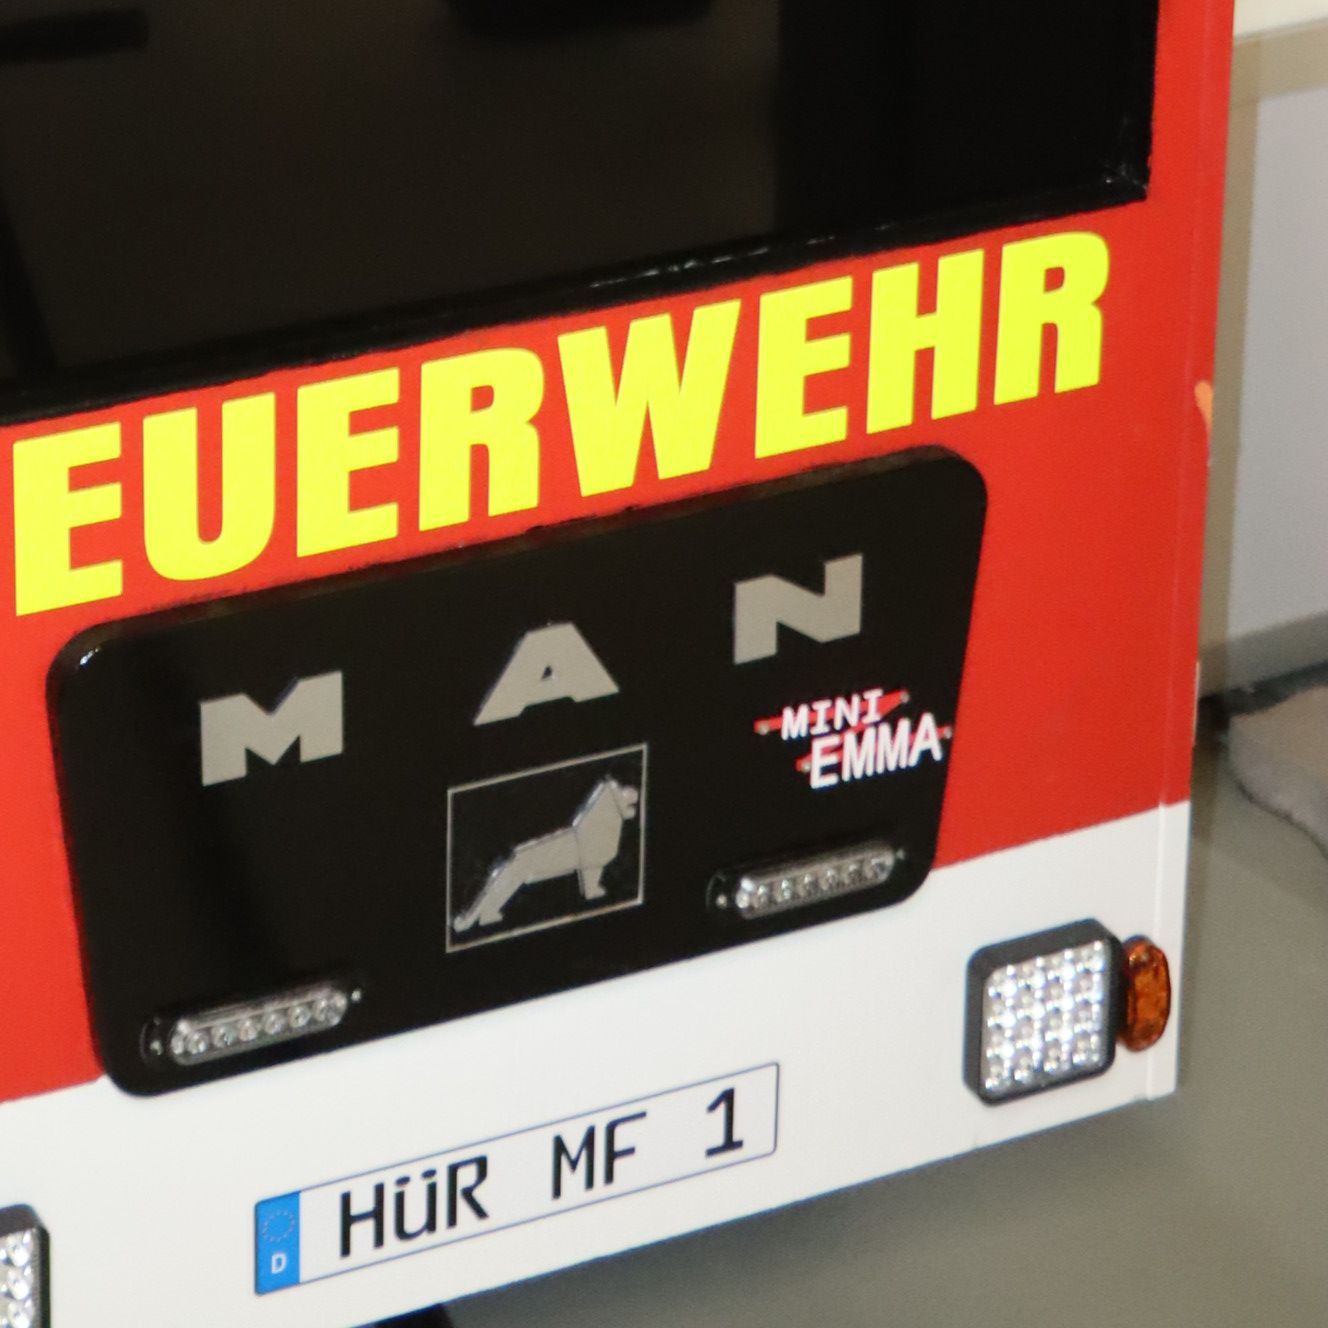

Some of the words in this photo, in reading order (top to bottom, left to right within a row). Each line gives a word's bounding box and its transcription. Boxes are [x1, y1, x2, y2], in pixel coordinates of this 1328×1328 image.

[200, 553, 864, 787] MAN
[780, 688, 884, 741] MINI
[809, 711, 944, 790] EMMA
[271, 1252, 288, 1275] D
[551, 1111, 647, 1200] MF
[705, 1087, 745, 1158] 1
